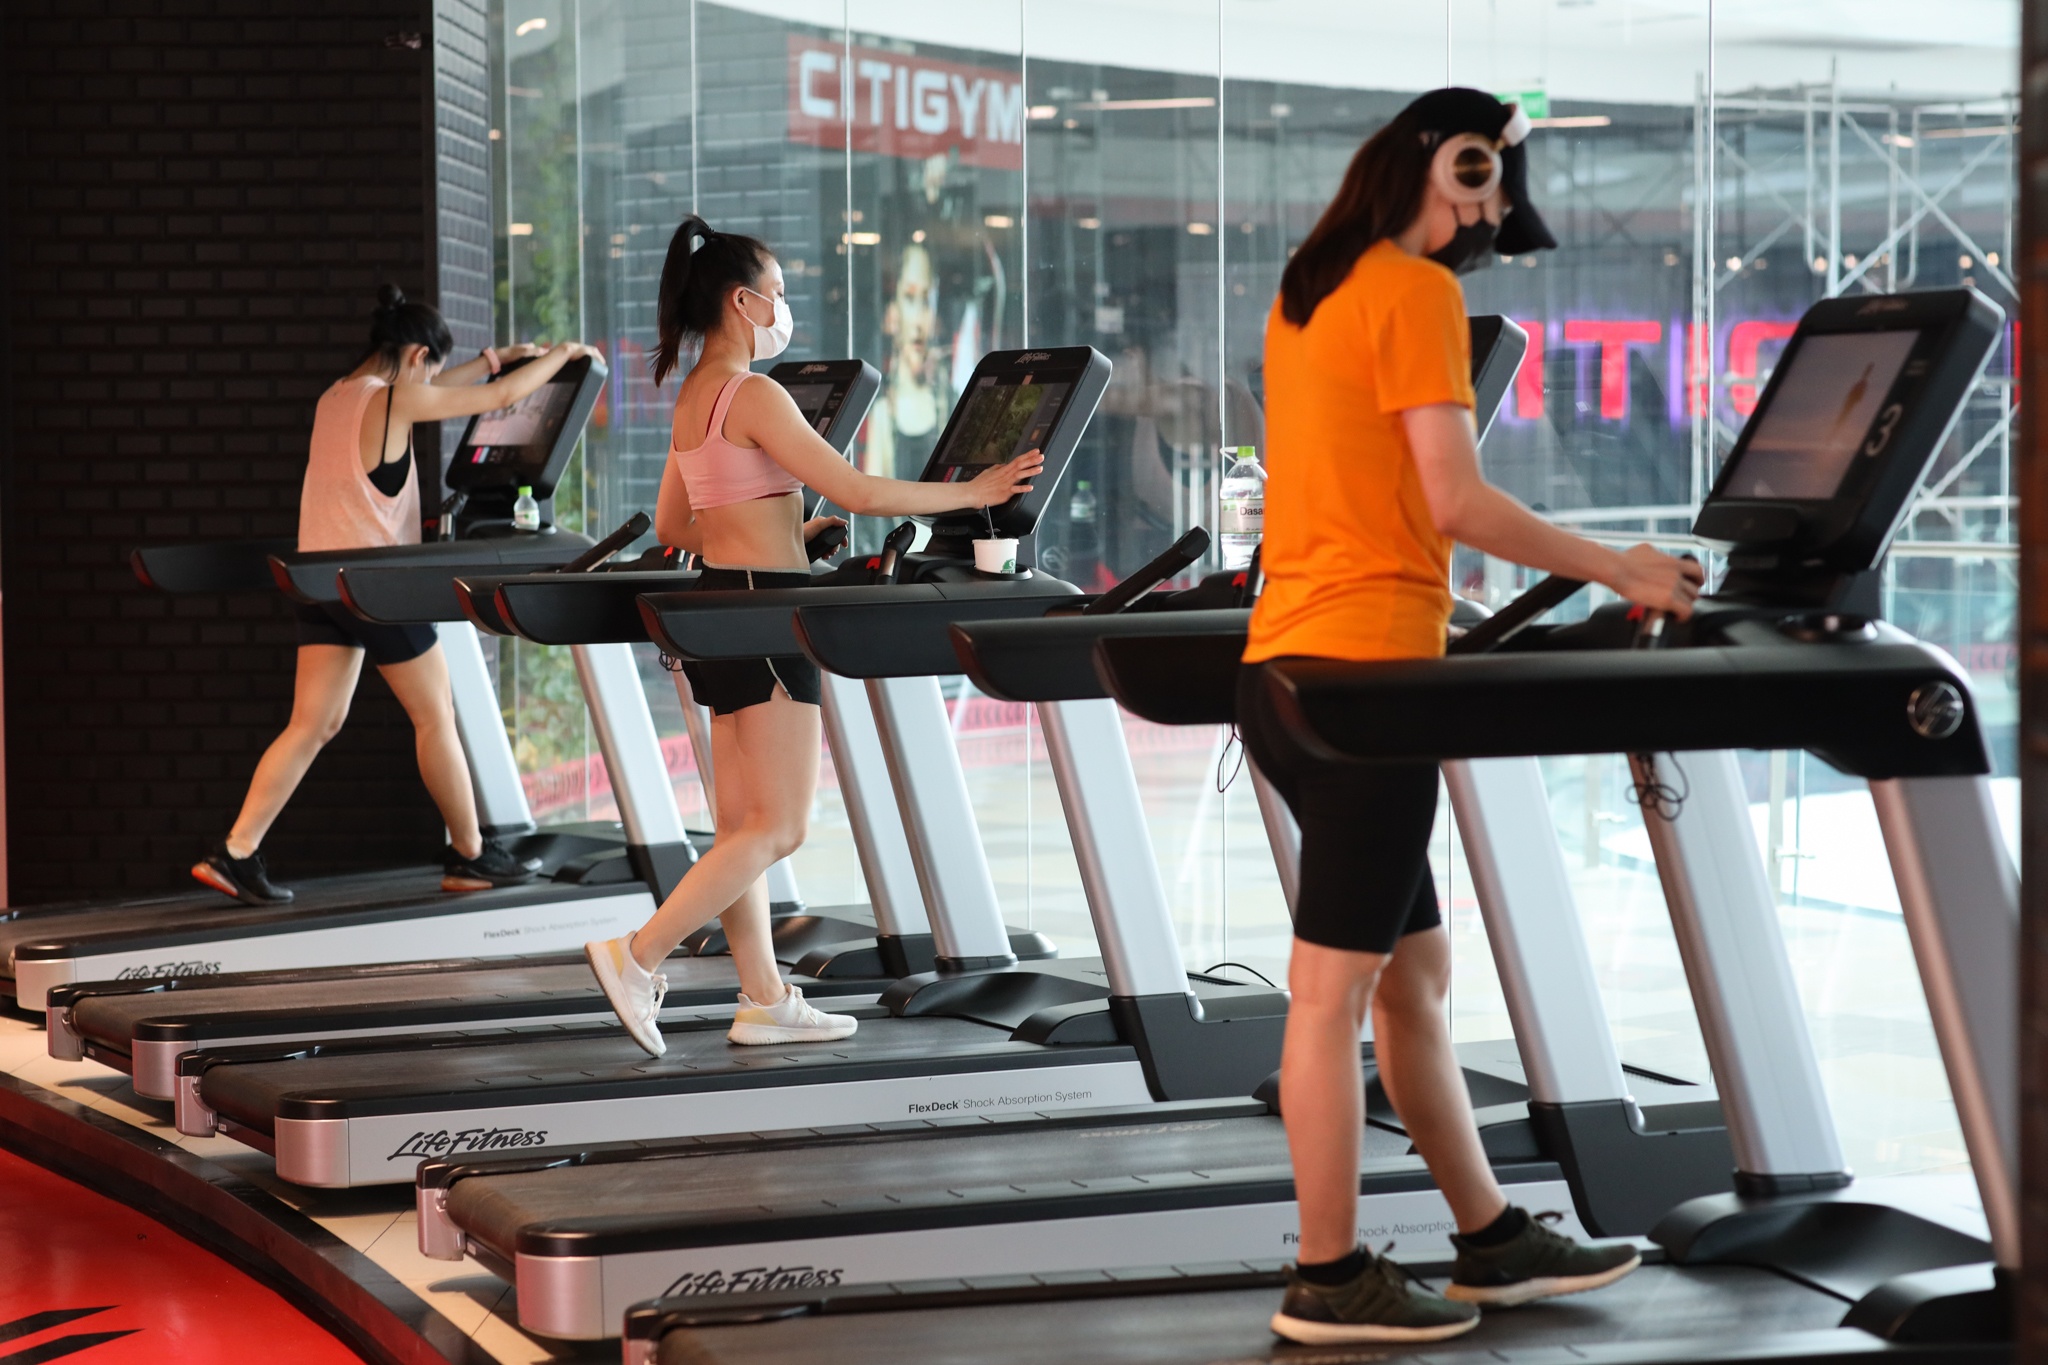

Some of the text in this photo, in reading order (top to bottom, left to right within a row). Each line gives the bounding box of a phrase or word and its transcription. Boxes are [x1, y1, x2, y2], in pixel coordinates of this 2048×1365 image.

[800, 50, 1021, 145] CITIGYM
[908, 1091, 1092, 1114] FlexDeck Shock Absorption System
[1356, 1225, 1388, 1238] hock
